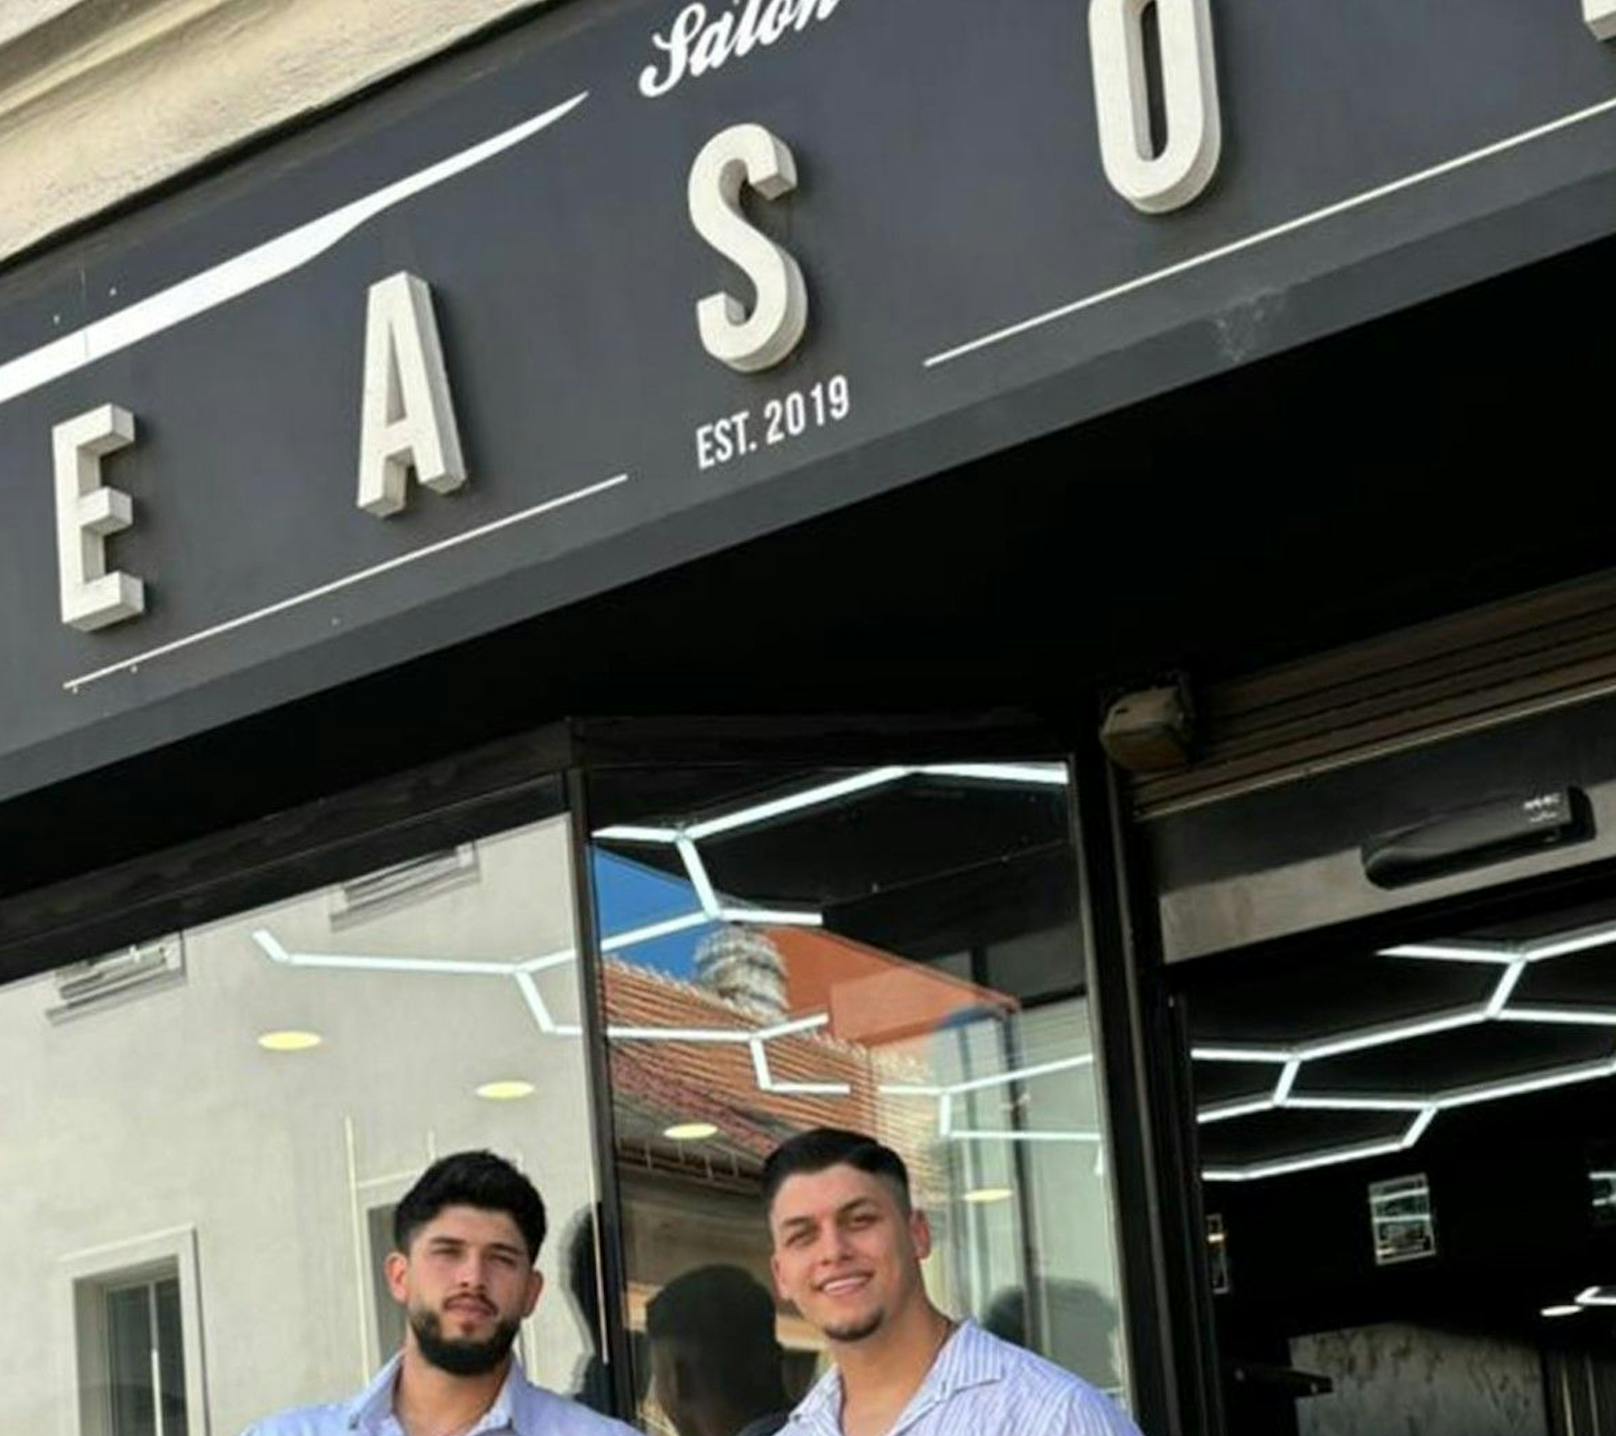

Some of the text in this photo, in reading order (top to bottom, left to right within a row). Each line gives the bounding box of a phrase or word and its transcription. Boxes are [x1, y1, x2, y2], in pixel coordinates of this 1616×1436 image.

[53, 0, 1616, 632] EASO
[696, 374, 849, 470] EST. 2019
